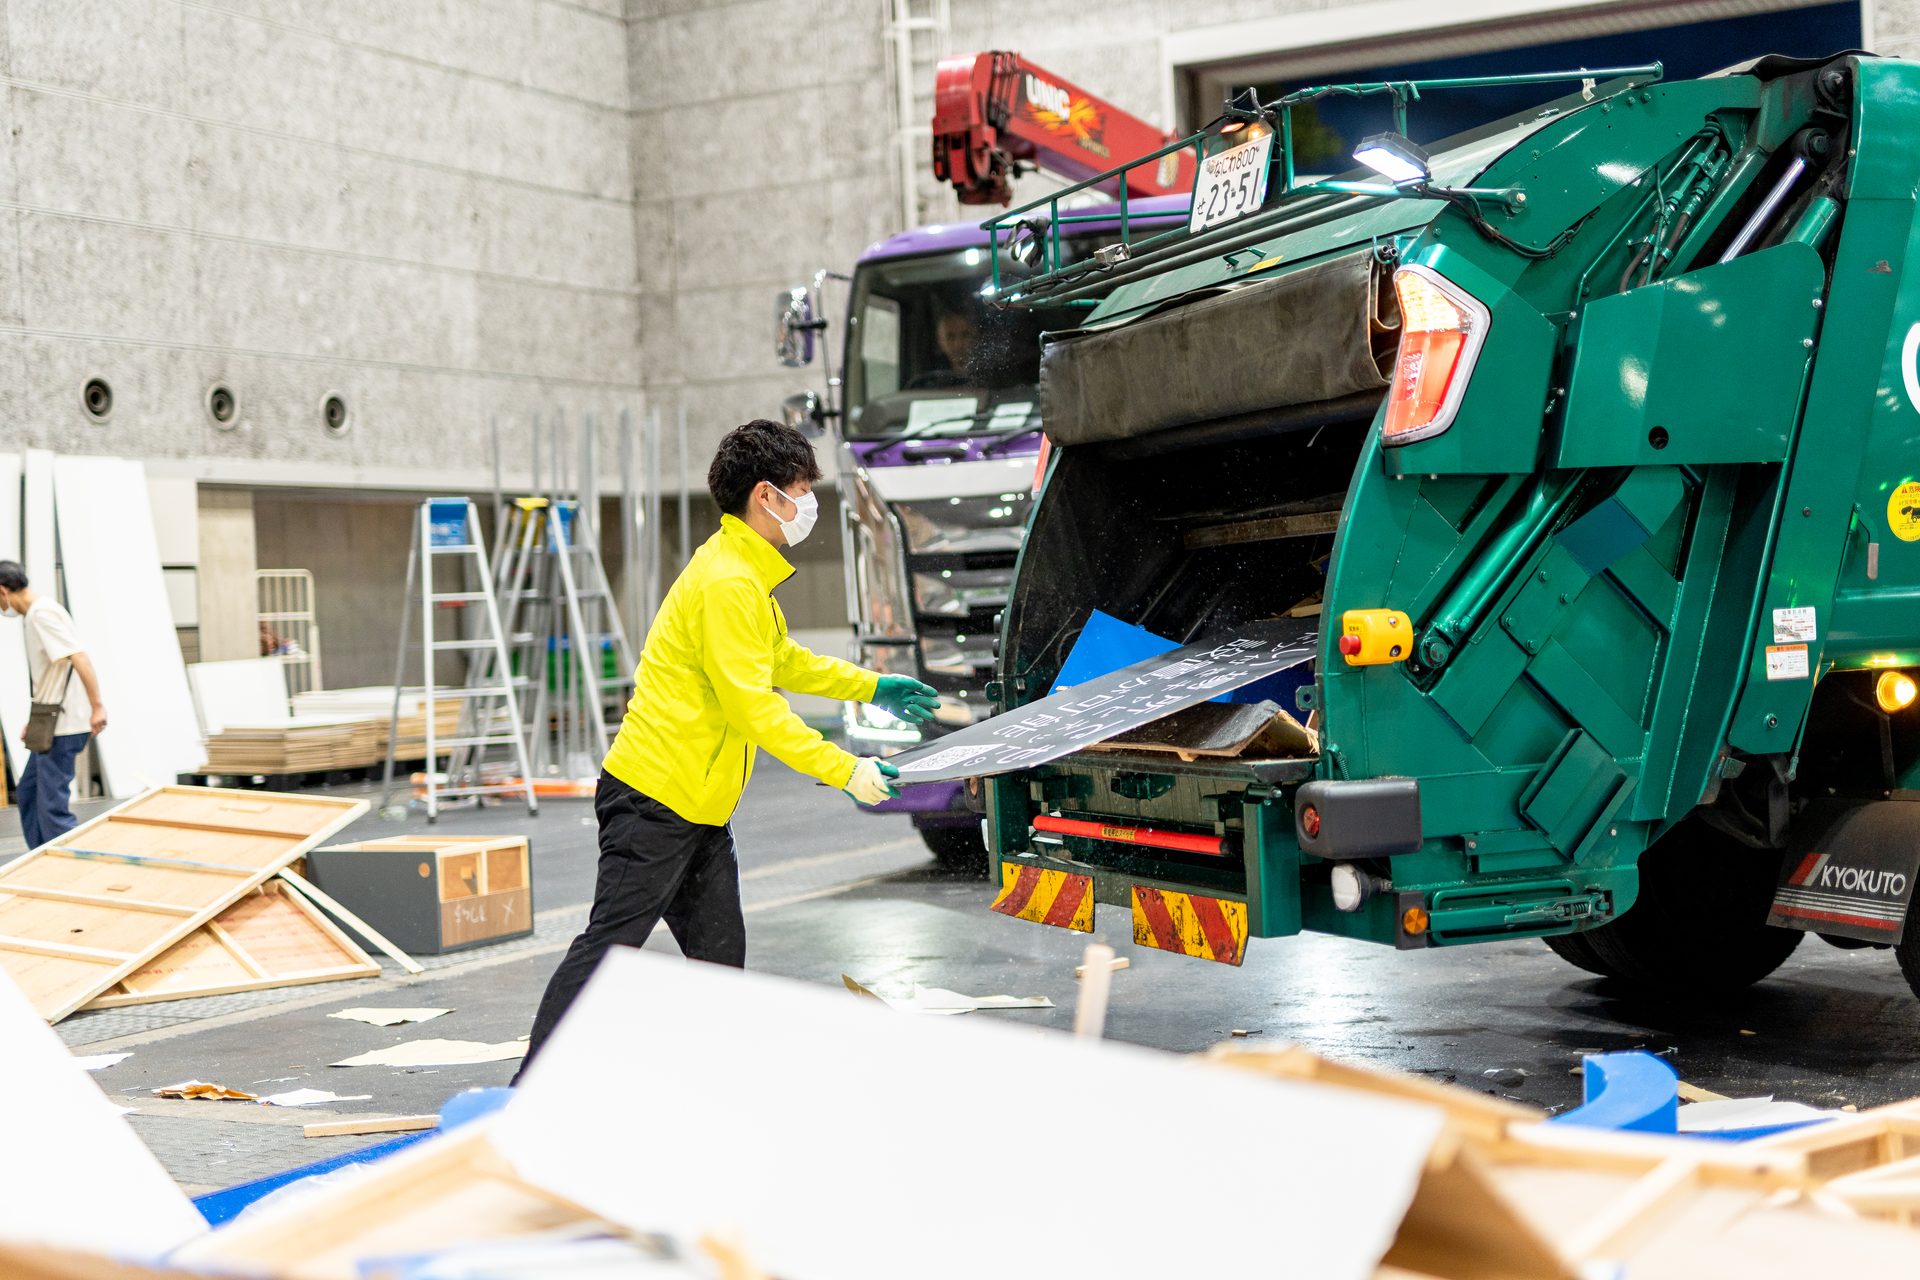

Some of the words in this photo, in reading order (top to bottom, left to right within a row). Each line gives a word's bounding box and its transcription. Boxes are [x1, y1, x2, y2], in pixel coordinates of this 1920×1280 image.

[1026, 73, 1070, 120] UNIC
[1206, 168, 1260, 221] 23-51
[993, 638, 1268, 738] 設置が可能
[1821, 865, 1906, 896] KYOKUTO
